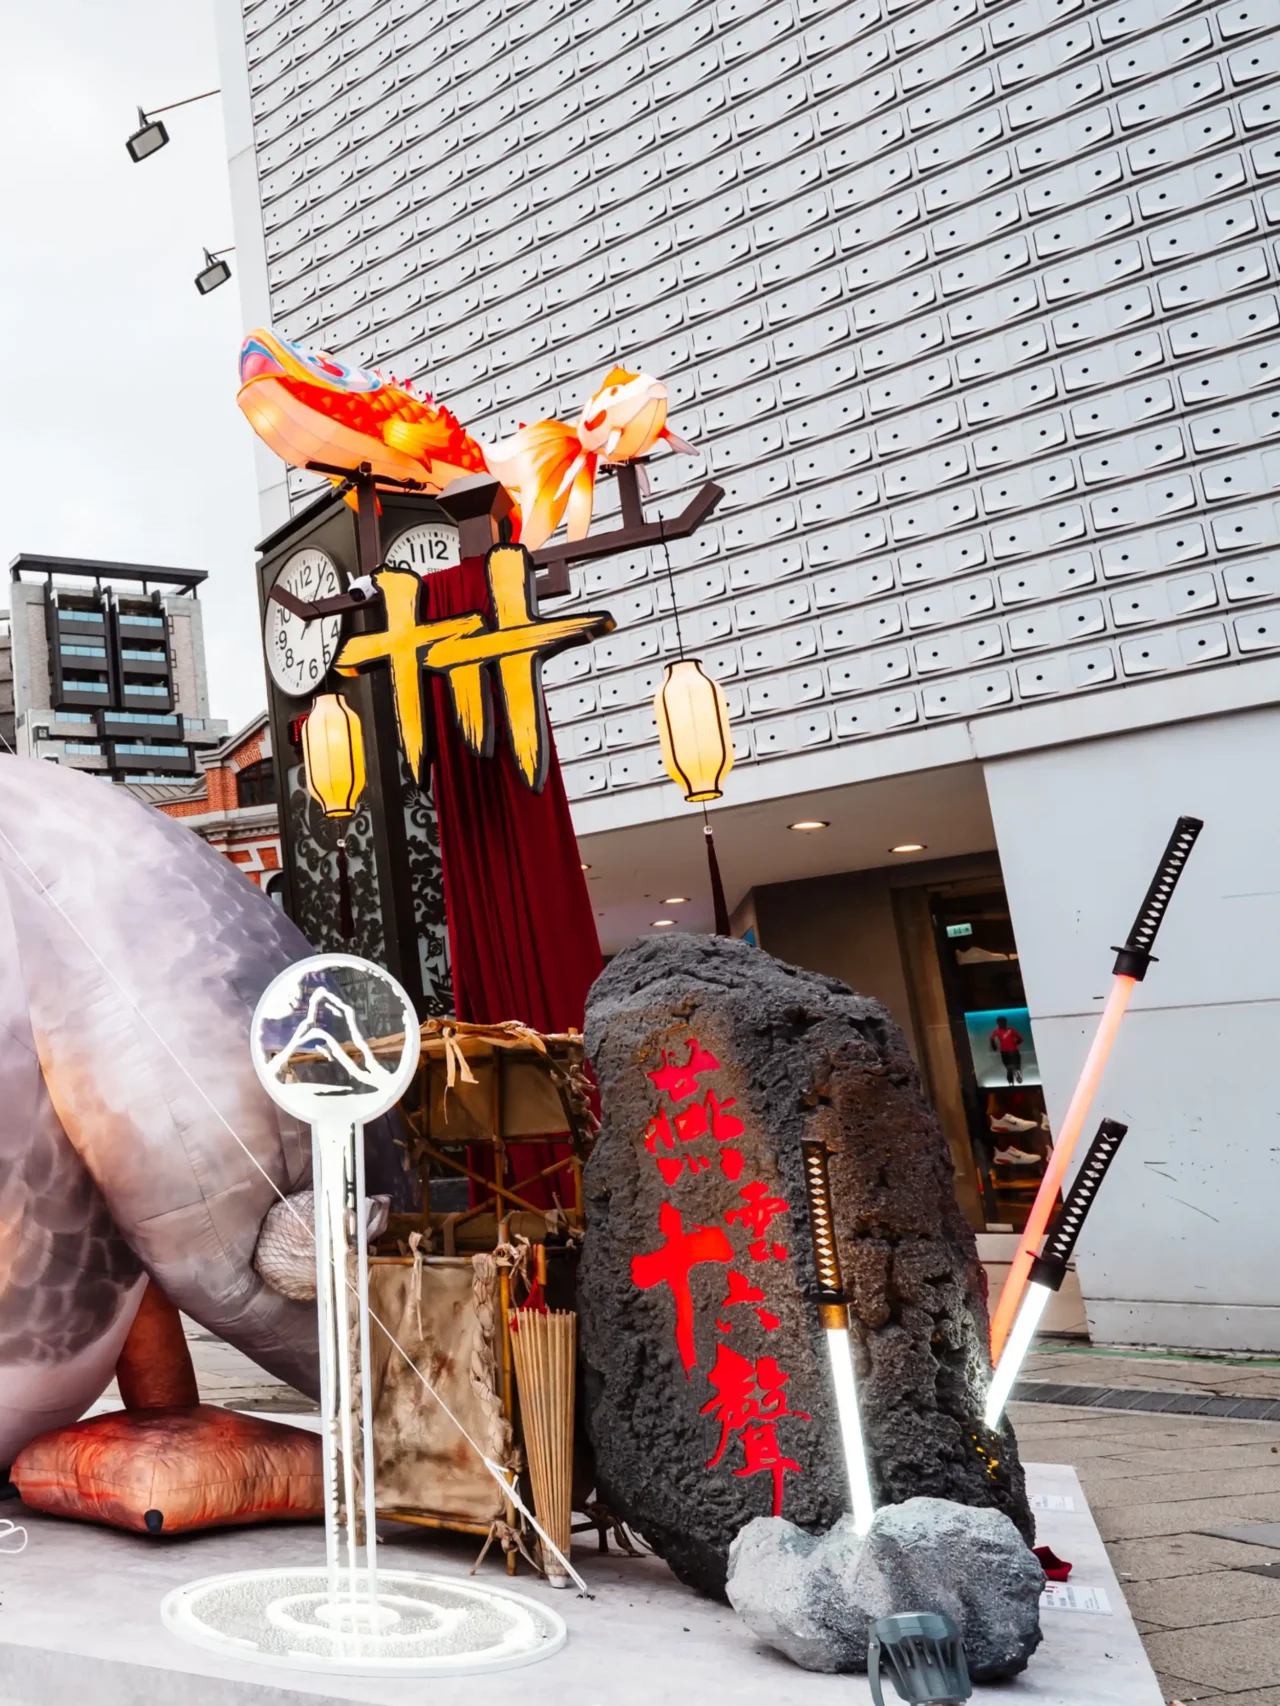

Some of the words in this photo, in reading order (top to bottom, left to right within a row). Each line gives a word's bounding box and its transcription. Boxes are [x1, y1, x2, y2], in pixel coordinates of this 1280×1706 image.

[428, 539, 450, 561] 12
[299, 564, 313, 589] 12
[326, 571, 336, 594] 2
[278, 629, 288, 650] 9
[331, 619, 340, 639] 4
[285, 648, 294, 669] 8
[308, 658, 319, 680] 6
[296, 659, 305, 681] 7
